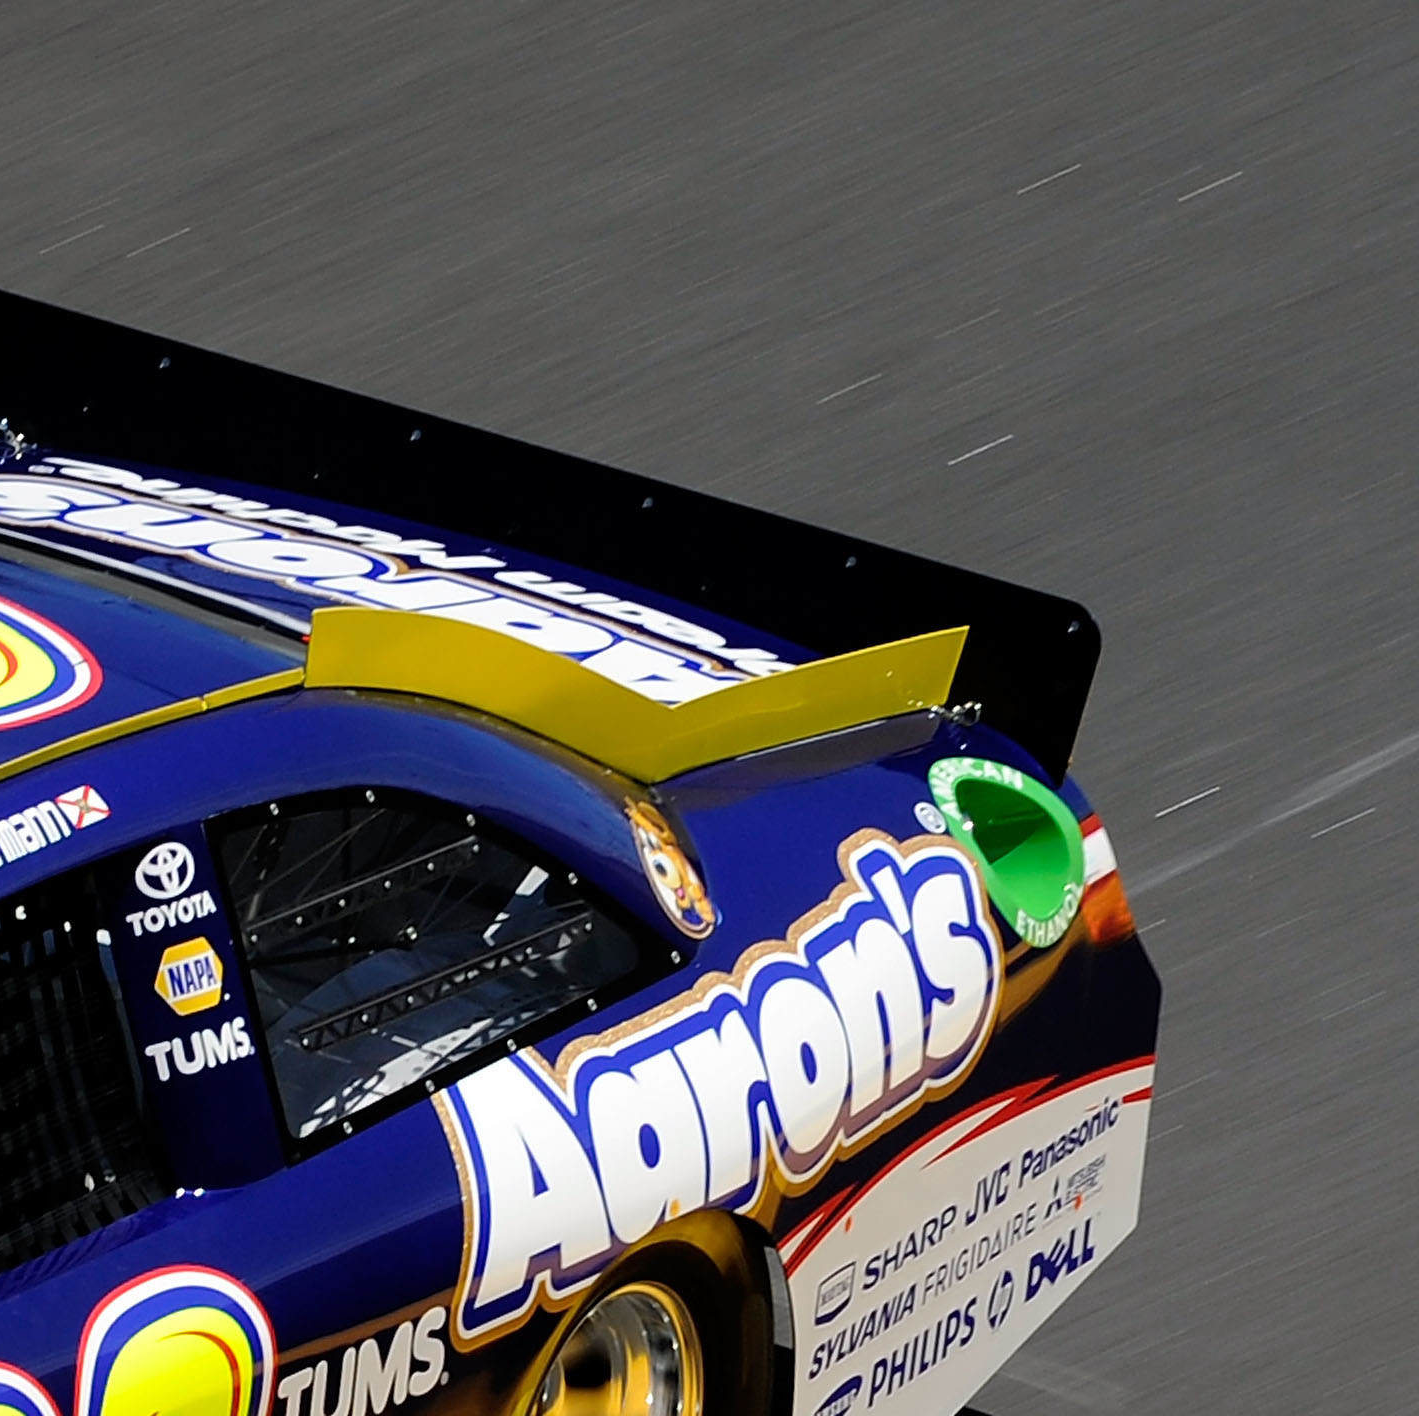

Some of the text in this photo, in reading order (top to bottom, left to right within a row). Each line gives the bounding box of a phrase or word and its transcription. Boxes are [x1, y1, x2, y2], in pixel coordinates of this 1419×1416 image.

[42, 457, 797, 676] ream Machine
[126, 891, 217, 937] TOYOTA
[168, 956, 217, 996] NAPA
[145, 1017, 251, 1082] TUMS
[443, 850, 999, 1326] Aaron's
[862, 1096, 1120, 1291] SHARP JVC Panasonic
[809, 1202, 1038, 1380] SYLVANIA FRIGIDAIRE
[868, 1218, 1095, 1408] PHILIPS DELL
